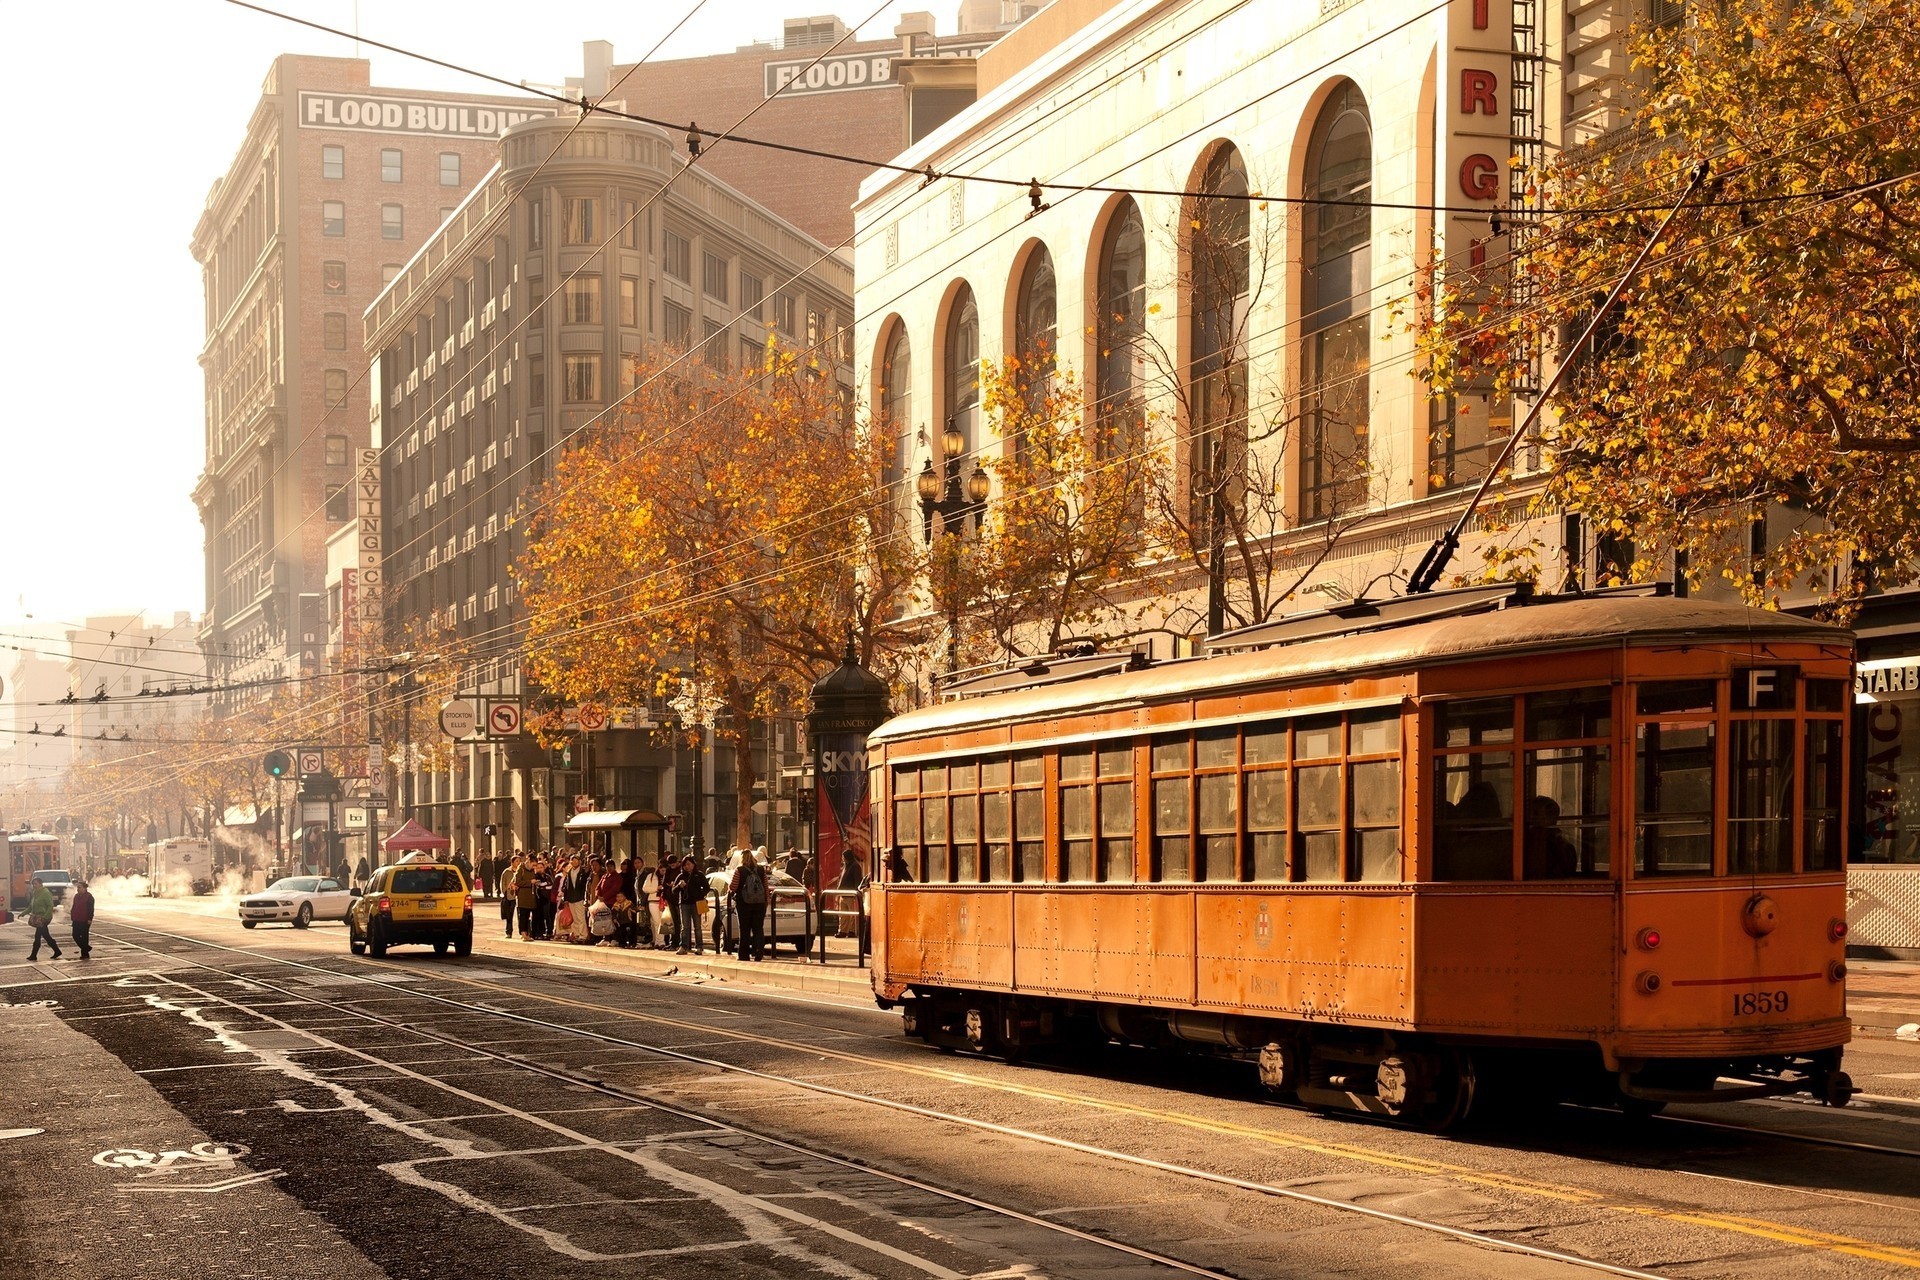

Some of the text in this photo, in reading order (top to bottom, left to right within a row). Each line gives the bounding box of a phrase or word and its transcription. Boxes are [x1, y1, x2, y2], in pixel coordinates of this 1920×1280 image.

[776, 60, 866, 91] FLOOD
[308, 98, 548, 135] FLOOD BUILDIN
[362, 451, 379, 549] SAVING
[1748, 670, 1776, 707] F
[1854, 665, 1919, 695] STARB
[818, 719, 874, 728] SAN FRANCISCO
[822, 751, 869, 773] SKYY
[1867, 703, 1902, 840] MAC
[822, 775, 868, 788] VODKA
[391, 900, 409, 908] 2744
[1250, 974, 1279, 997] 1859
[1733, 990, 1789, 1017] 1859
